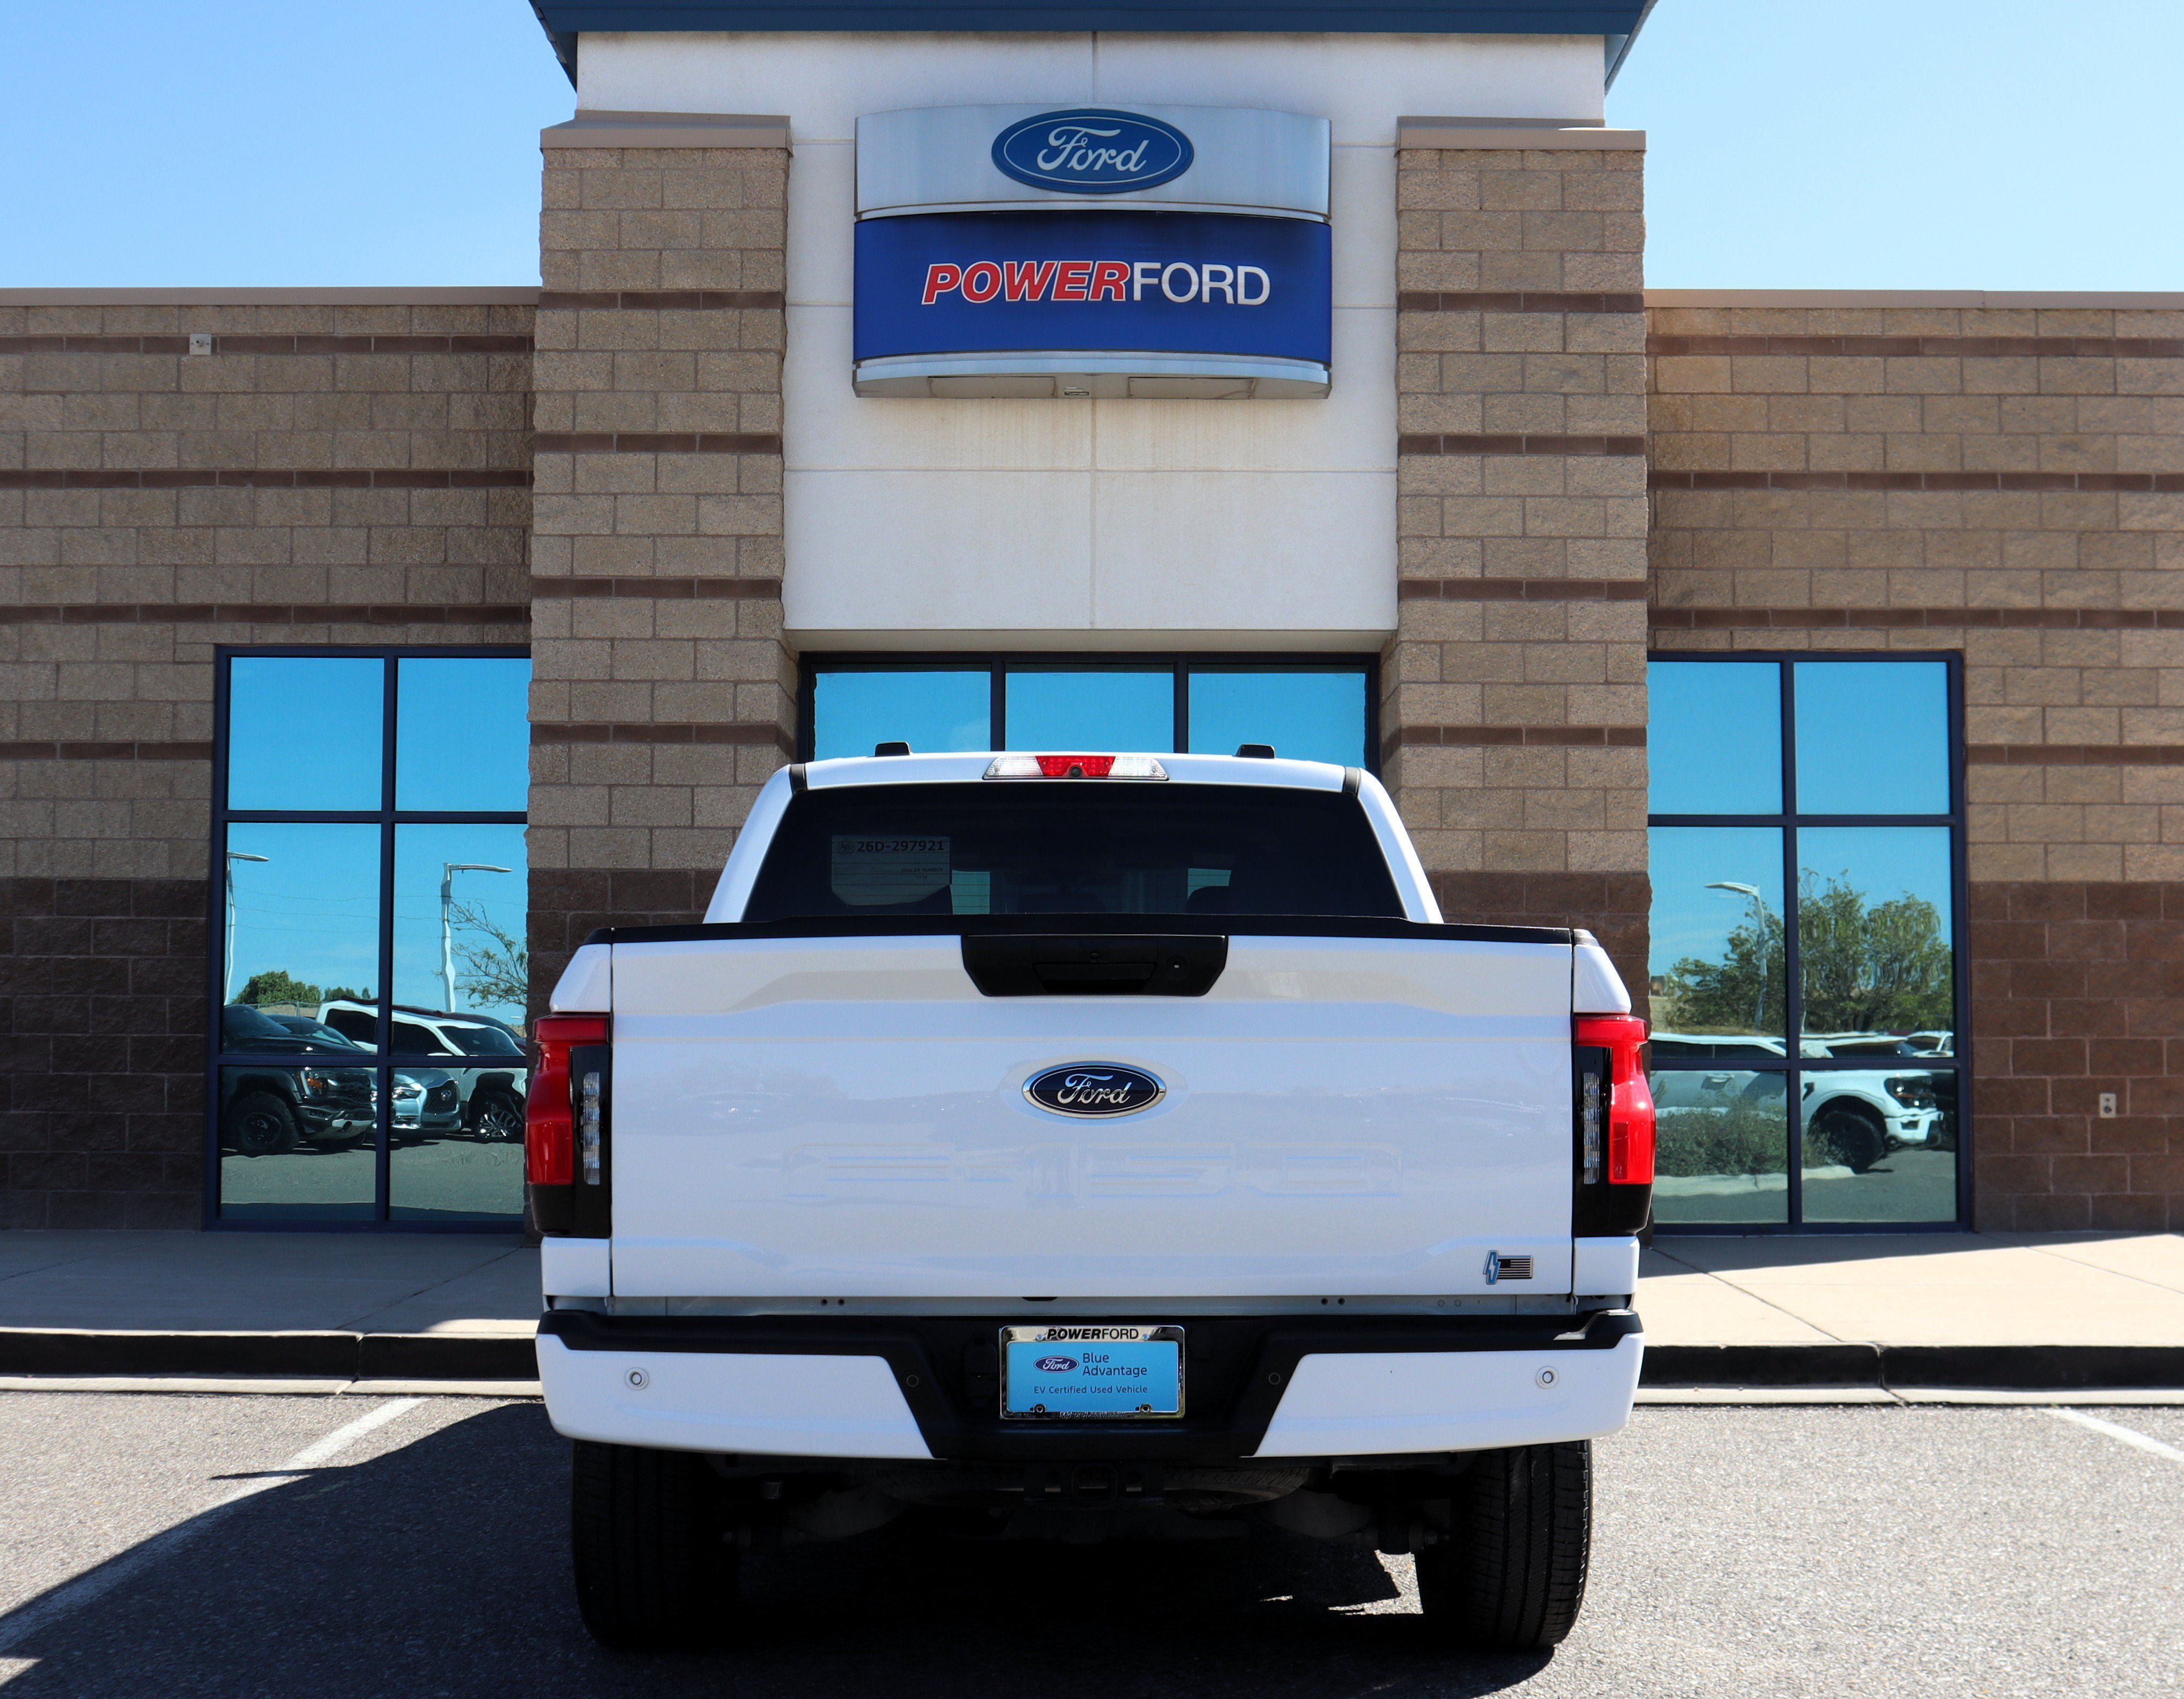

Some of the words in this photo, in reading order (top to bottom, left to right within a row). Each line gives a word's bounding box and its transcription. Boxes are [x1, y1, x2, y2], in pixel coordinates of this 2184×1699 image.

[1037, 125, 1149, 172] Ford
[921, 260, 1270, 306] POWERFORD
[857, 840, 944, 852] 26D-297921
[1057, 1074, 1132, 1104] Ford
[1046, 1328, 1139, 1340] POWERFORD
[1083, 1353, 1109, 1363] Blue
[1042, 1358, 1070, 1371] Ford
[1082, 1365, 1148, 1377] Advantage
[1049, 1386, 1087, 1394] Certified
[1116, 1385, 1148, 1393] Vehicle
